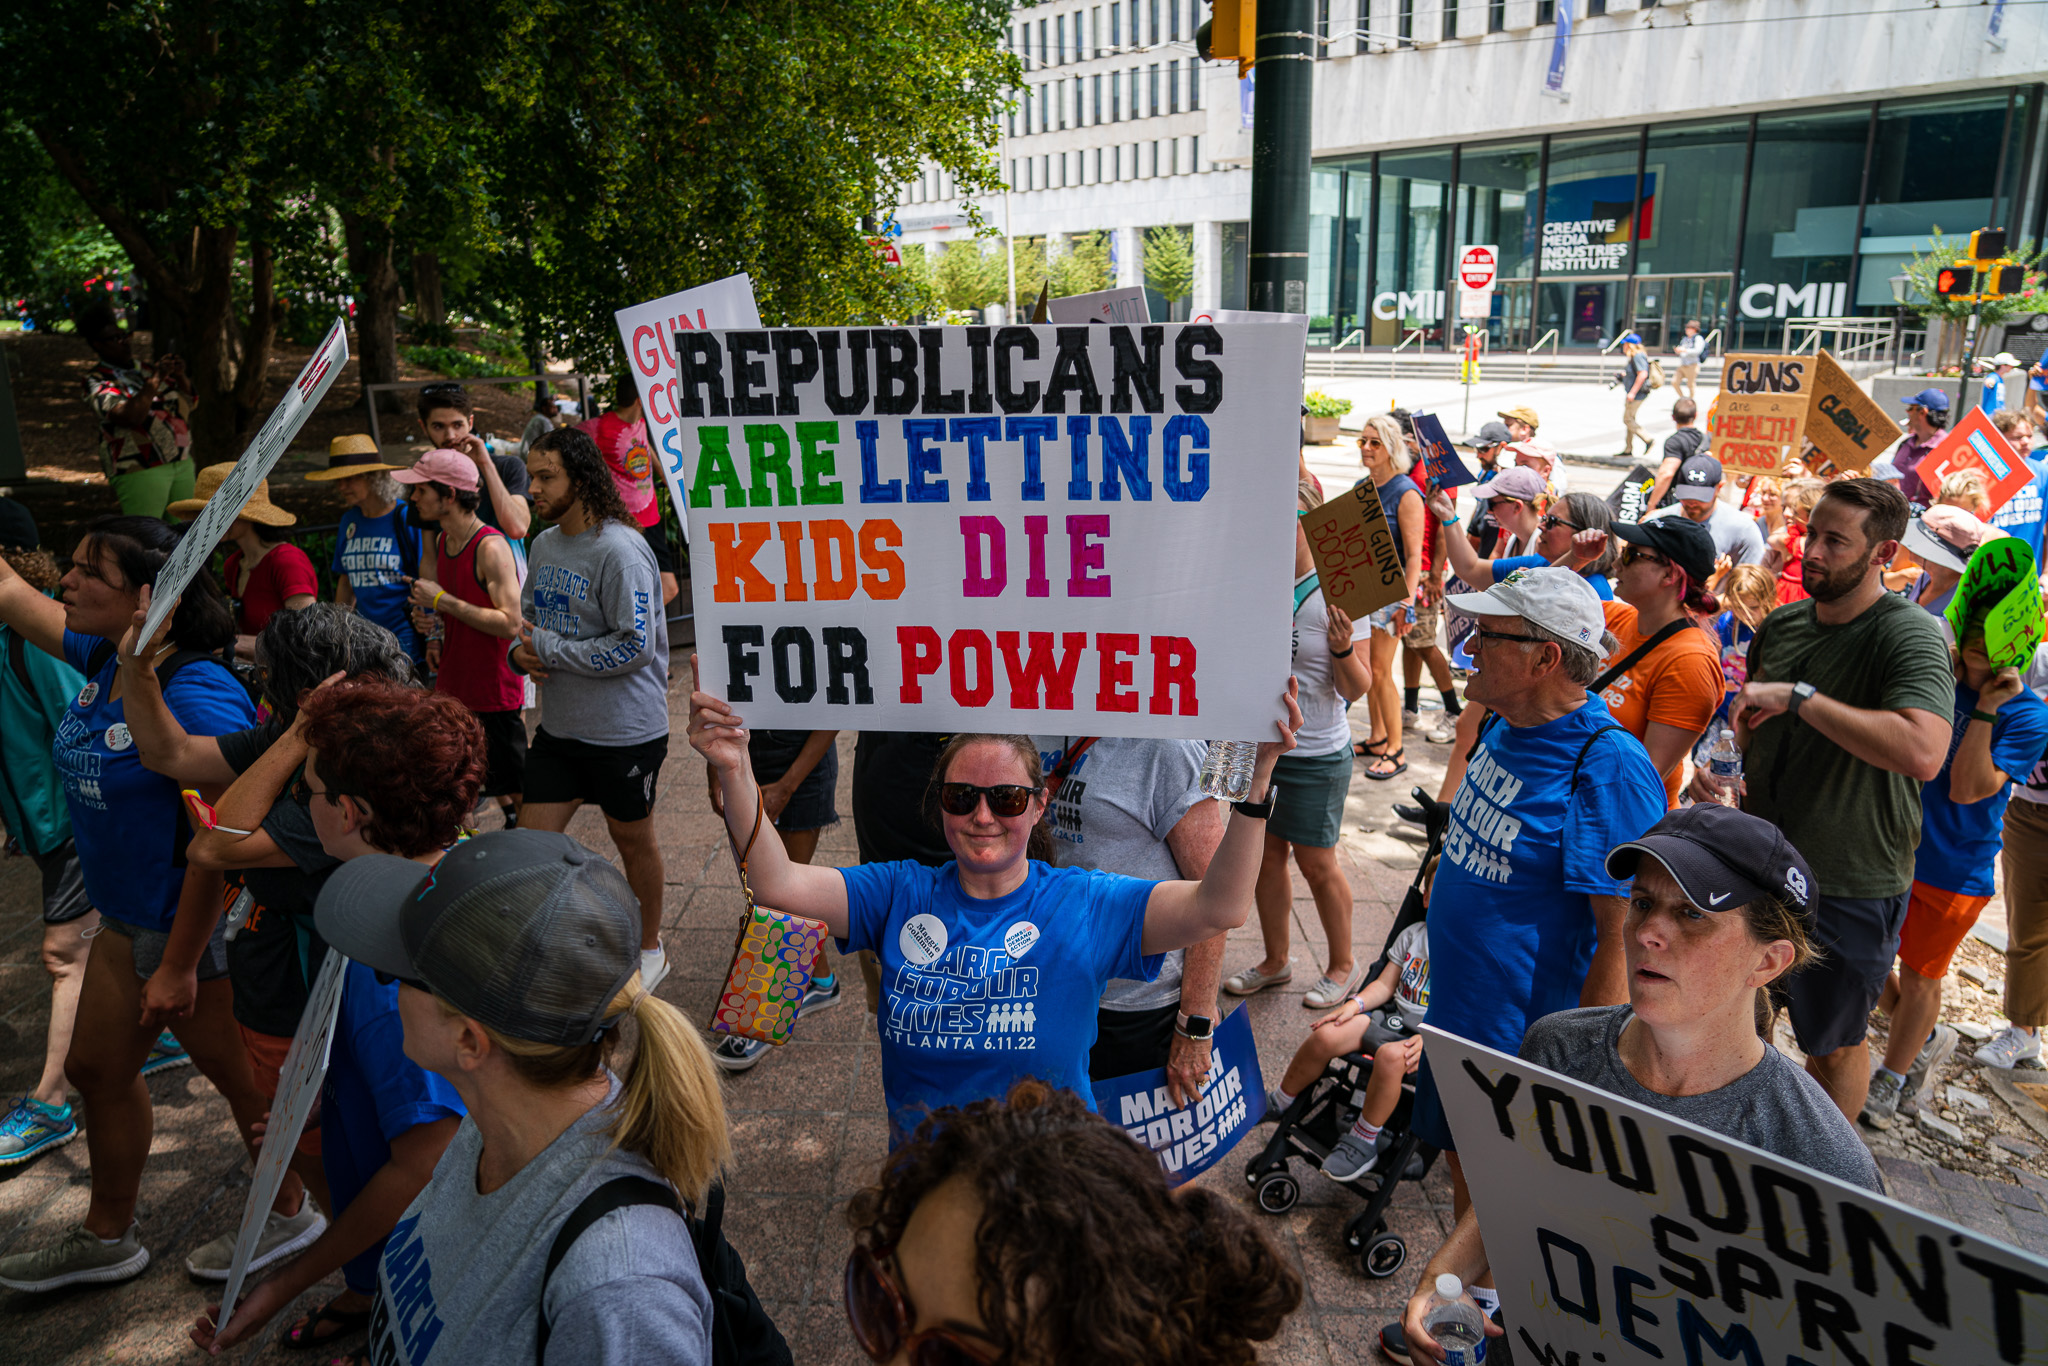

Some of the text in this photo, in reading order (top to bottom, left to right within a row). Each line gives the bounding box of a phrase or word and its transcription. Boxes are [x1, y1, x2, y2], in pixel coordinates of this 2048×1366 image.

[1542, 234, 1589, 246] MEDIA
[1543, 219, 1616, 234] CREATIVE
[1540, 255, 1620, 271] INSTITUTE
[1541, 243, 1628, 259] INDUSTRIES
[1371, 291, 1445, 321] CMII
[1739, 282, 1847, 319] CMII
[675, 325, 1224, 417] REPUBLICANS
[1727, 361, 1804, 394] GUNS
[1716, 415, 1796, 442] HEALTH
[690, 421, 843, 508] ARE
[856, 414, 1211, 503] LETTING
[1341, 524, 1373, 569] NOT
[1355, 484, 1401, 586] BAN GUNS
[708, 514, 1111, 602] KIDS DIE
[1311, 519, 1355, 598] BOOKS
[555, 568, 590, 600] STATE
[591, 589, 649, 672] PANTHERS
[722, 625, 1199, 716] FOR POWER
[107, 729, 117, 748] NRA
[1467, 797, 1522, 852] OUR
[907, 923, 935, 959] Goldman
[917, 923, 940, 954] Maggie
[1006, 930, 1024, 943] MOMS
[1008, 931, 1032, 948] DEMAND
[1010, 937, 1031, 952] ACTION
[894, 965, 968, 1004] FOR
[887, 994, 985, 1034] LIVES
[885, 1027, 1036, 1050] ATLANTA 6.11.22
[1196, 1066, 1242, 1128] OUR
[1462, 1057, 1656, 1194] YOU
